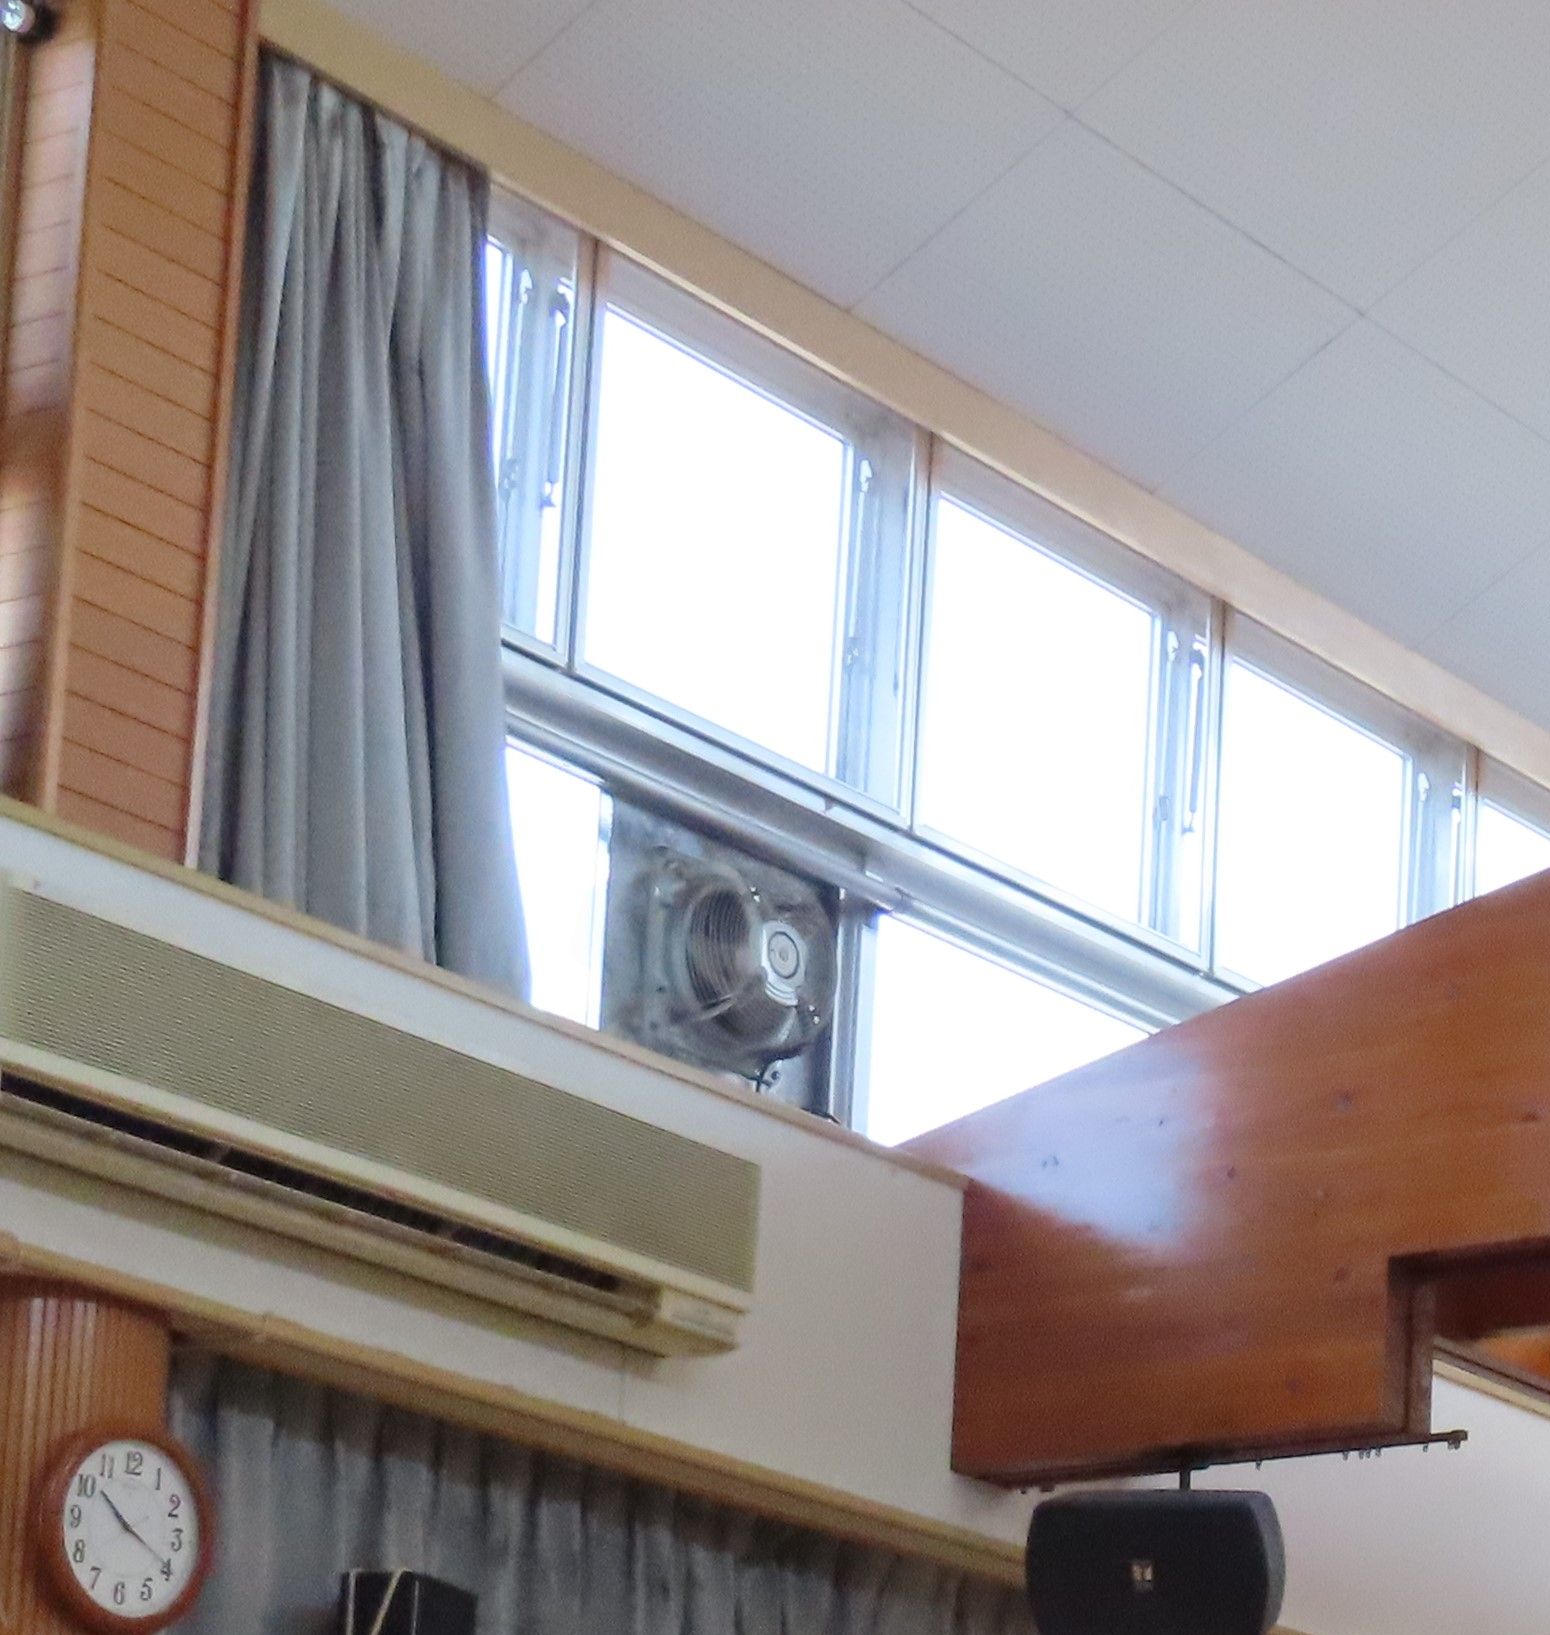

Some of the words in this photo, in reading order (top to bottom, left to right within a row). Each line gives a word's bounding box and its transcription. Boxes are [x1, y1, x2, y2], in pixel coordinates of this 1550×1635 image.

[100, 1454, 115, 1478] 11
[124, 1451, 144, 1476] 12
[77, 1474, 96, 1498] 10
[155, 1468, 161, 1490] 1
[70, 1505, 82, 1528] 9
[168, 1494, 181, 1518] 2
[73, 1540, 86, 1563] 8
[171, 1528, 183, 1552] 3
[90, 1567, 102, 1590] 7
[161, 1559, 173, 1582] 4
[114, 1582, 125, 1605] 6
[140, 1578, 153, 1601] 5
